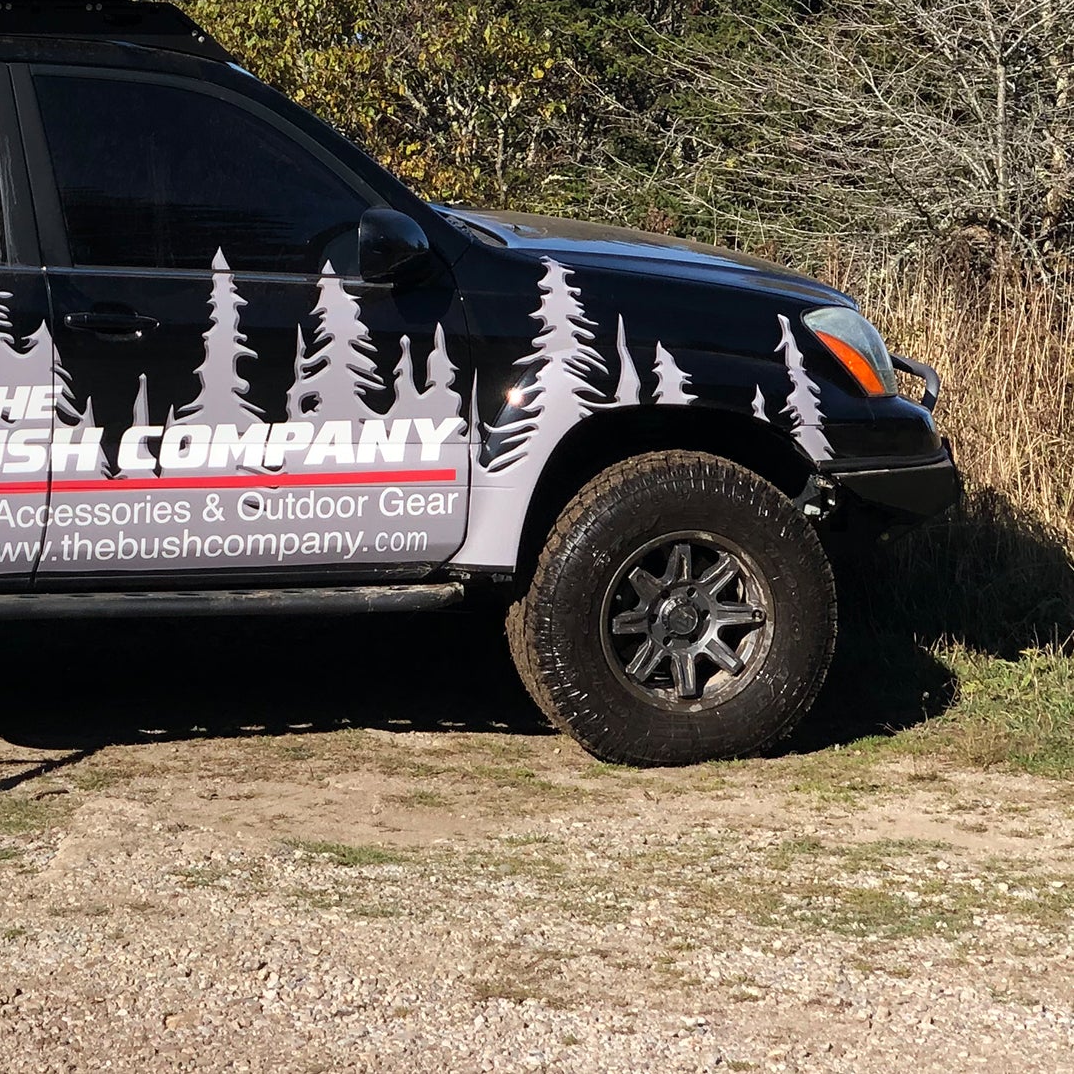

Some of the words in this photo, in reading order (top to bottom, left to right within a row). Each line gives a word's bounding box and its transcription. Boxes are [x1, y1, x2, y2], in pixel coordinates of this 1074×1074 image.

[117, 417, 464, 469] COMPANY
[202, 493, 226, 523] &
[237, 490, 369, 522] Outdoor
[379, 487, 459, 517] Gear
